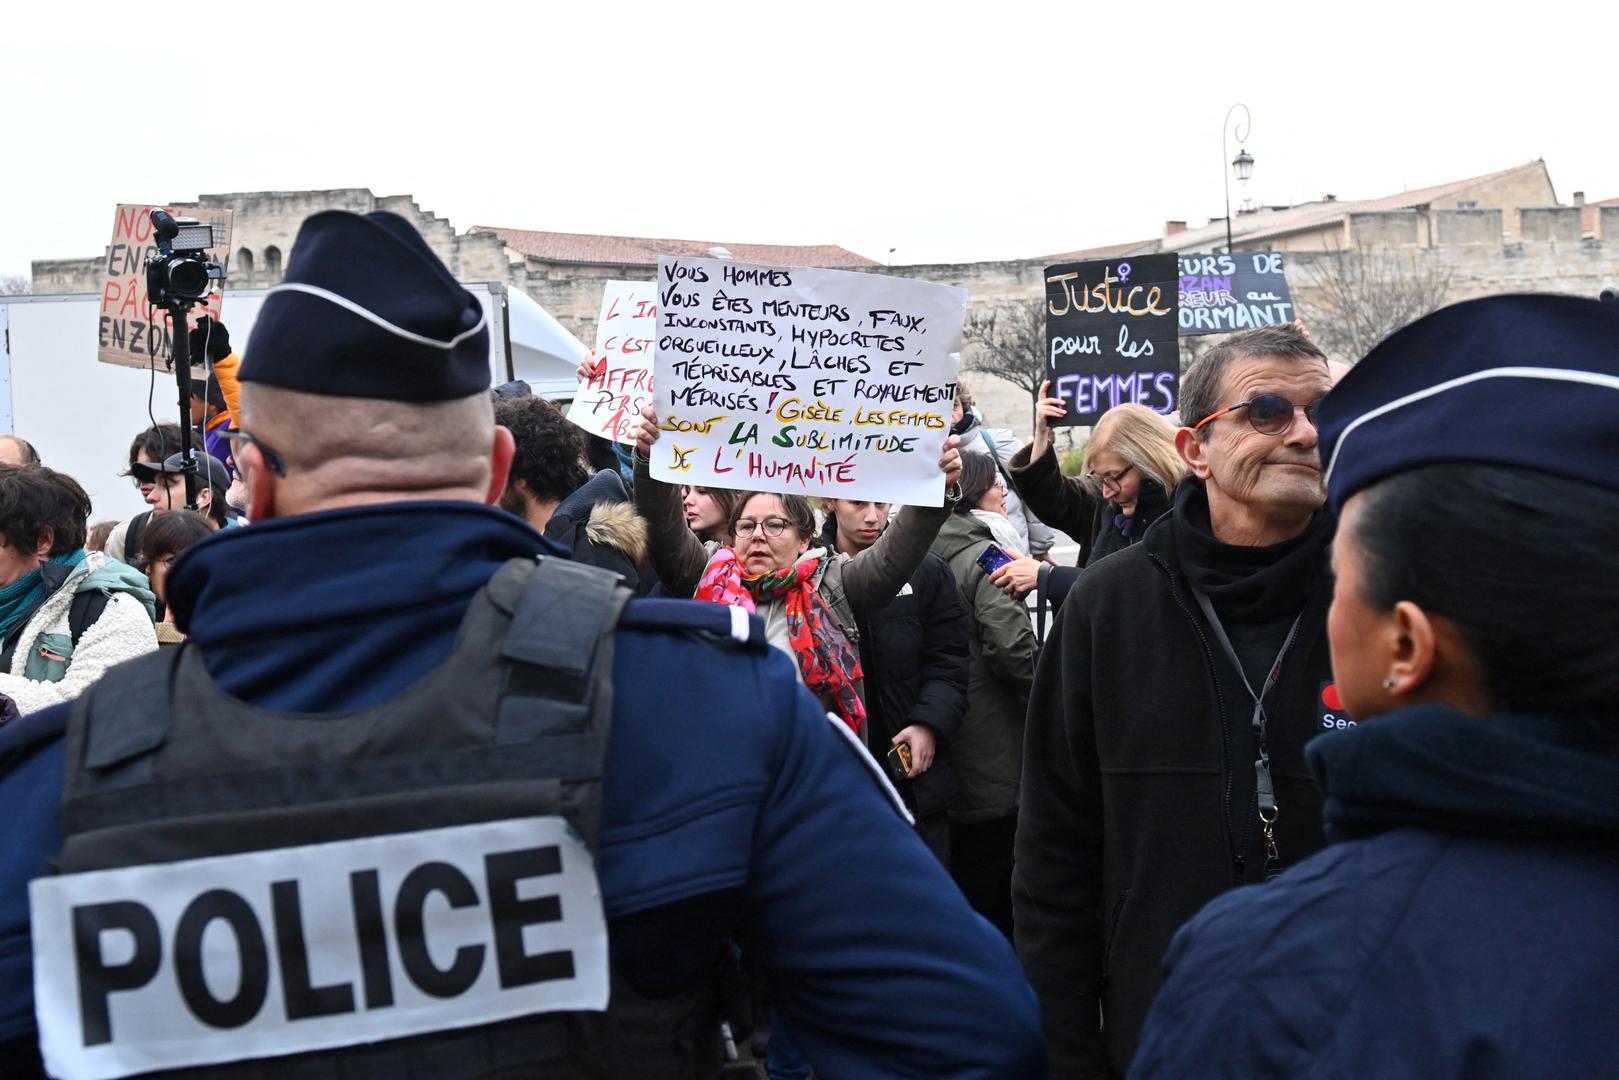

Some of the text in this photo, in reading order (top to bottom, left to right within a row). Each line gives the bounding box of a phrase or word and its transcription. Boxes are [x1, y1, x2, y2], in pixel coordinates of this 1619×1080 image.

[664, 261, 792, 287] VOUS HOMMES
[1252, 253, 1284, 275] DE
[1047, 266, 1171, 317] Justice
[1246, 291, 1282, 301] au
[661, 282, 700, 308] VOUS
[712, 289, 753, 314] ÊTES
[869, 310, 927, 334] FAUX,
[664, 313, 782, 342] INCONSTANTS,
[791, 346, 871, 374] LÂCHES
[888, 360, 925, 376] ET
[1051, 324, 1154, 369] pour les
[813, 378, 848, 397] ET
[854, 379, 957, 404] ROYALEMENT
[1056, 371, 1177, 415] FEMMES
[656, 415, 731, 435] SONT
[728, 421, 758, 446] LA
[887, 410, 947, 430] FEMMES
[668, 444, 699, 471] DE
[71, 844, 576, 1048] POLICE
